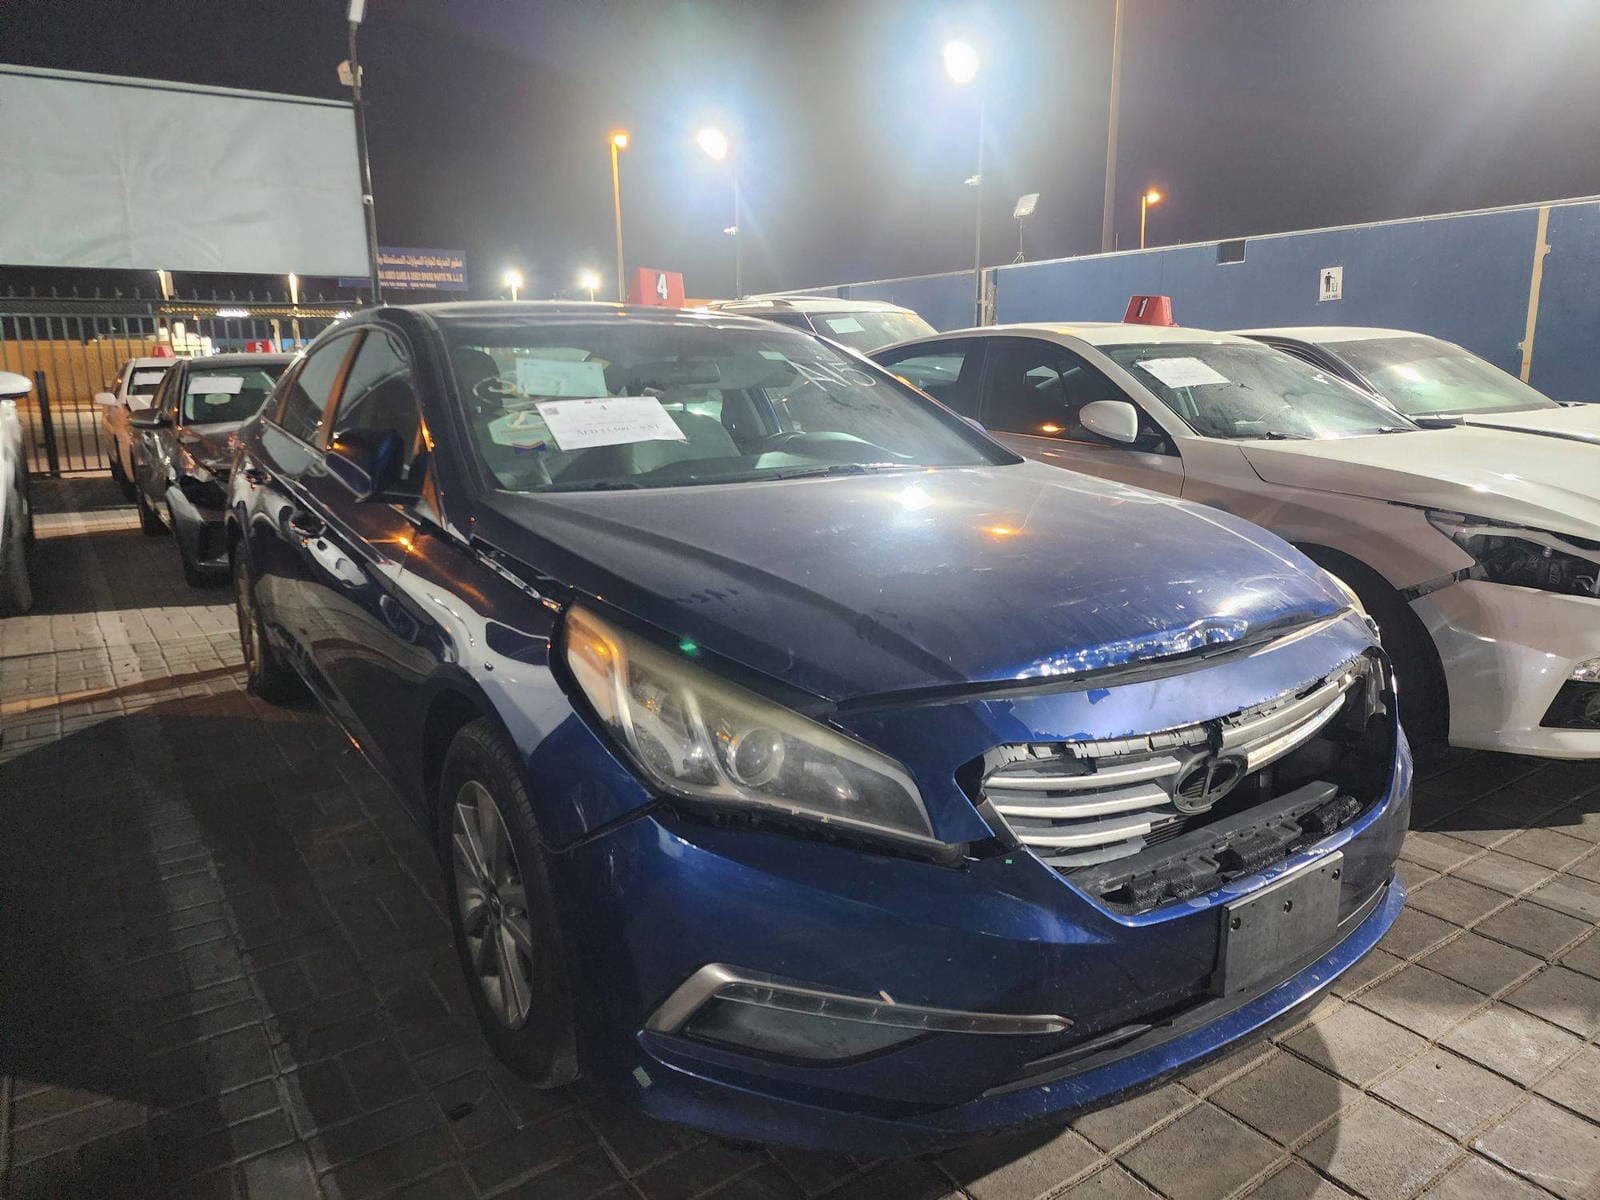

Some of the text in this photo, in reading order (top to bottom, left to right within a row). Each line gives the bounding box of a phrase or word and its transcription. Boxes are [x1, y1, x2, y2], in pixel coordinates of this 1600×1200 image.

[657, 273, 668, 300] 4
[1138, 297, 1148, 318] 1
[255, 341, 263, 353] 5
